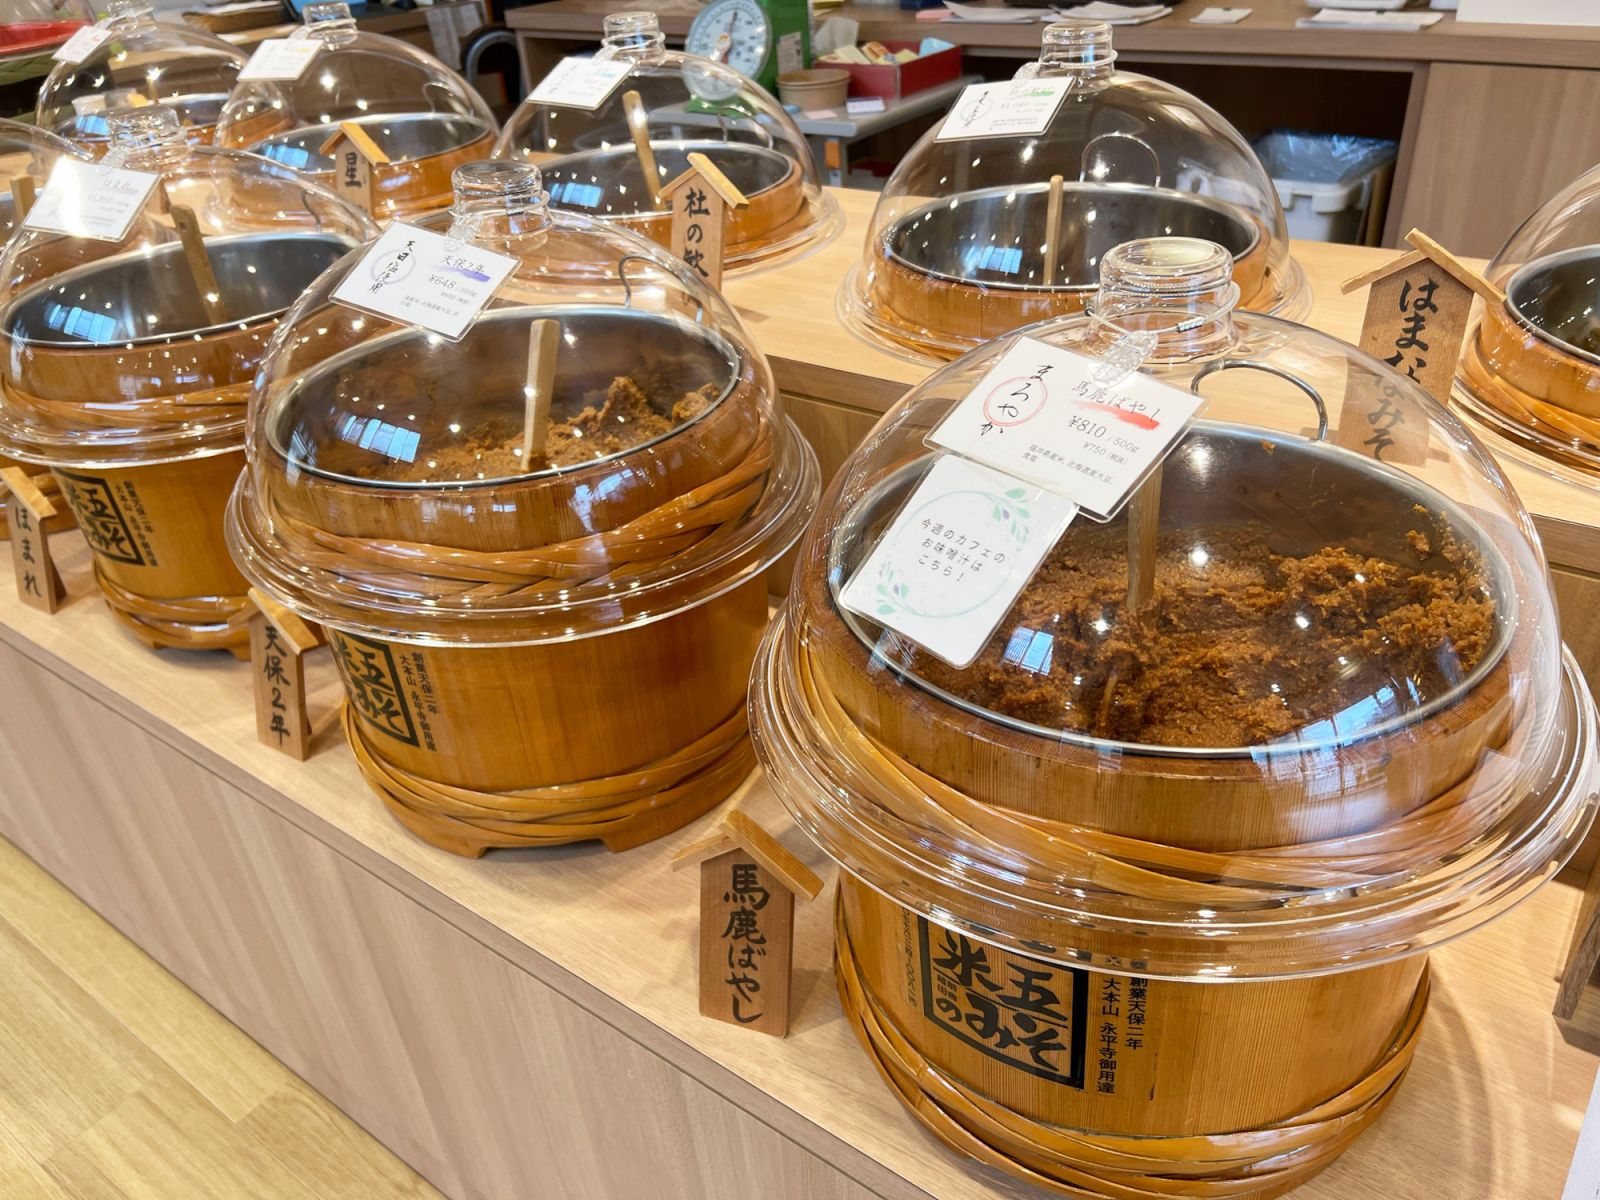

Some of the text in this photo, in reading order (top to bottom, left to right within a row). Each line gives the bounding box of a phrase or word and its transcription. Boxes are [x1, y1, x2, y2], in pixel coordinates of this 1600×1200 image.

[428, 273, 457, 290] ¥648
[980, 365, 1053, 436] まろやか
[1069, 415, 1106, 438] ¥810
[920, 518, 1006, 564] 今週のカフェの
[921, 538, 982, 572] お味噌汁は
[264, 625, 291, 747] 天保2年
[721, 863, 770, 1023] 馬鹿ばやし
[1097, 979, 1121, 1094] 大本山 永平寺御用達
[1125, 977, 1148, 1050] 創業天保二年
